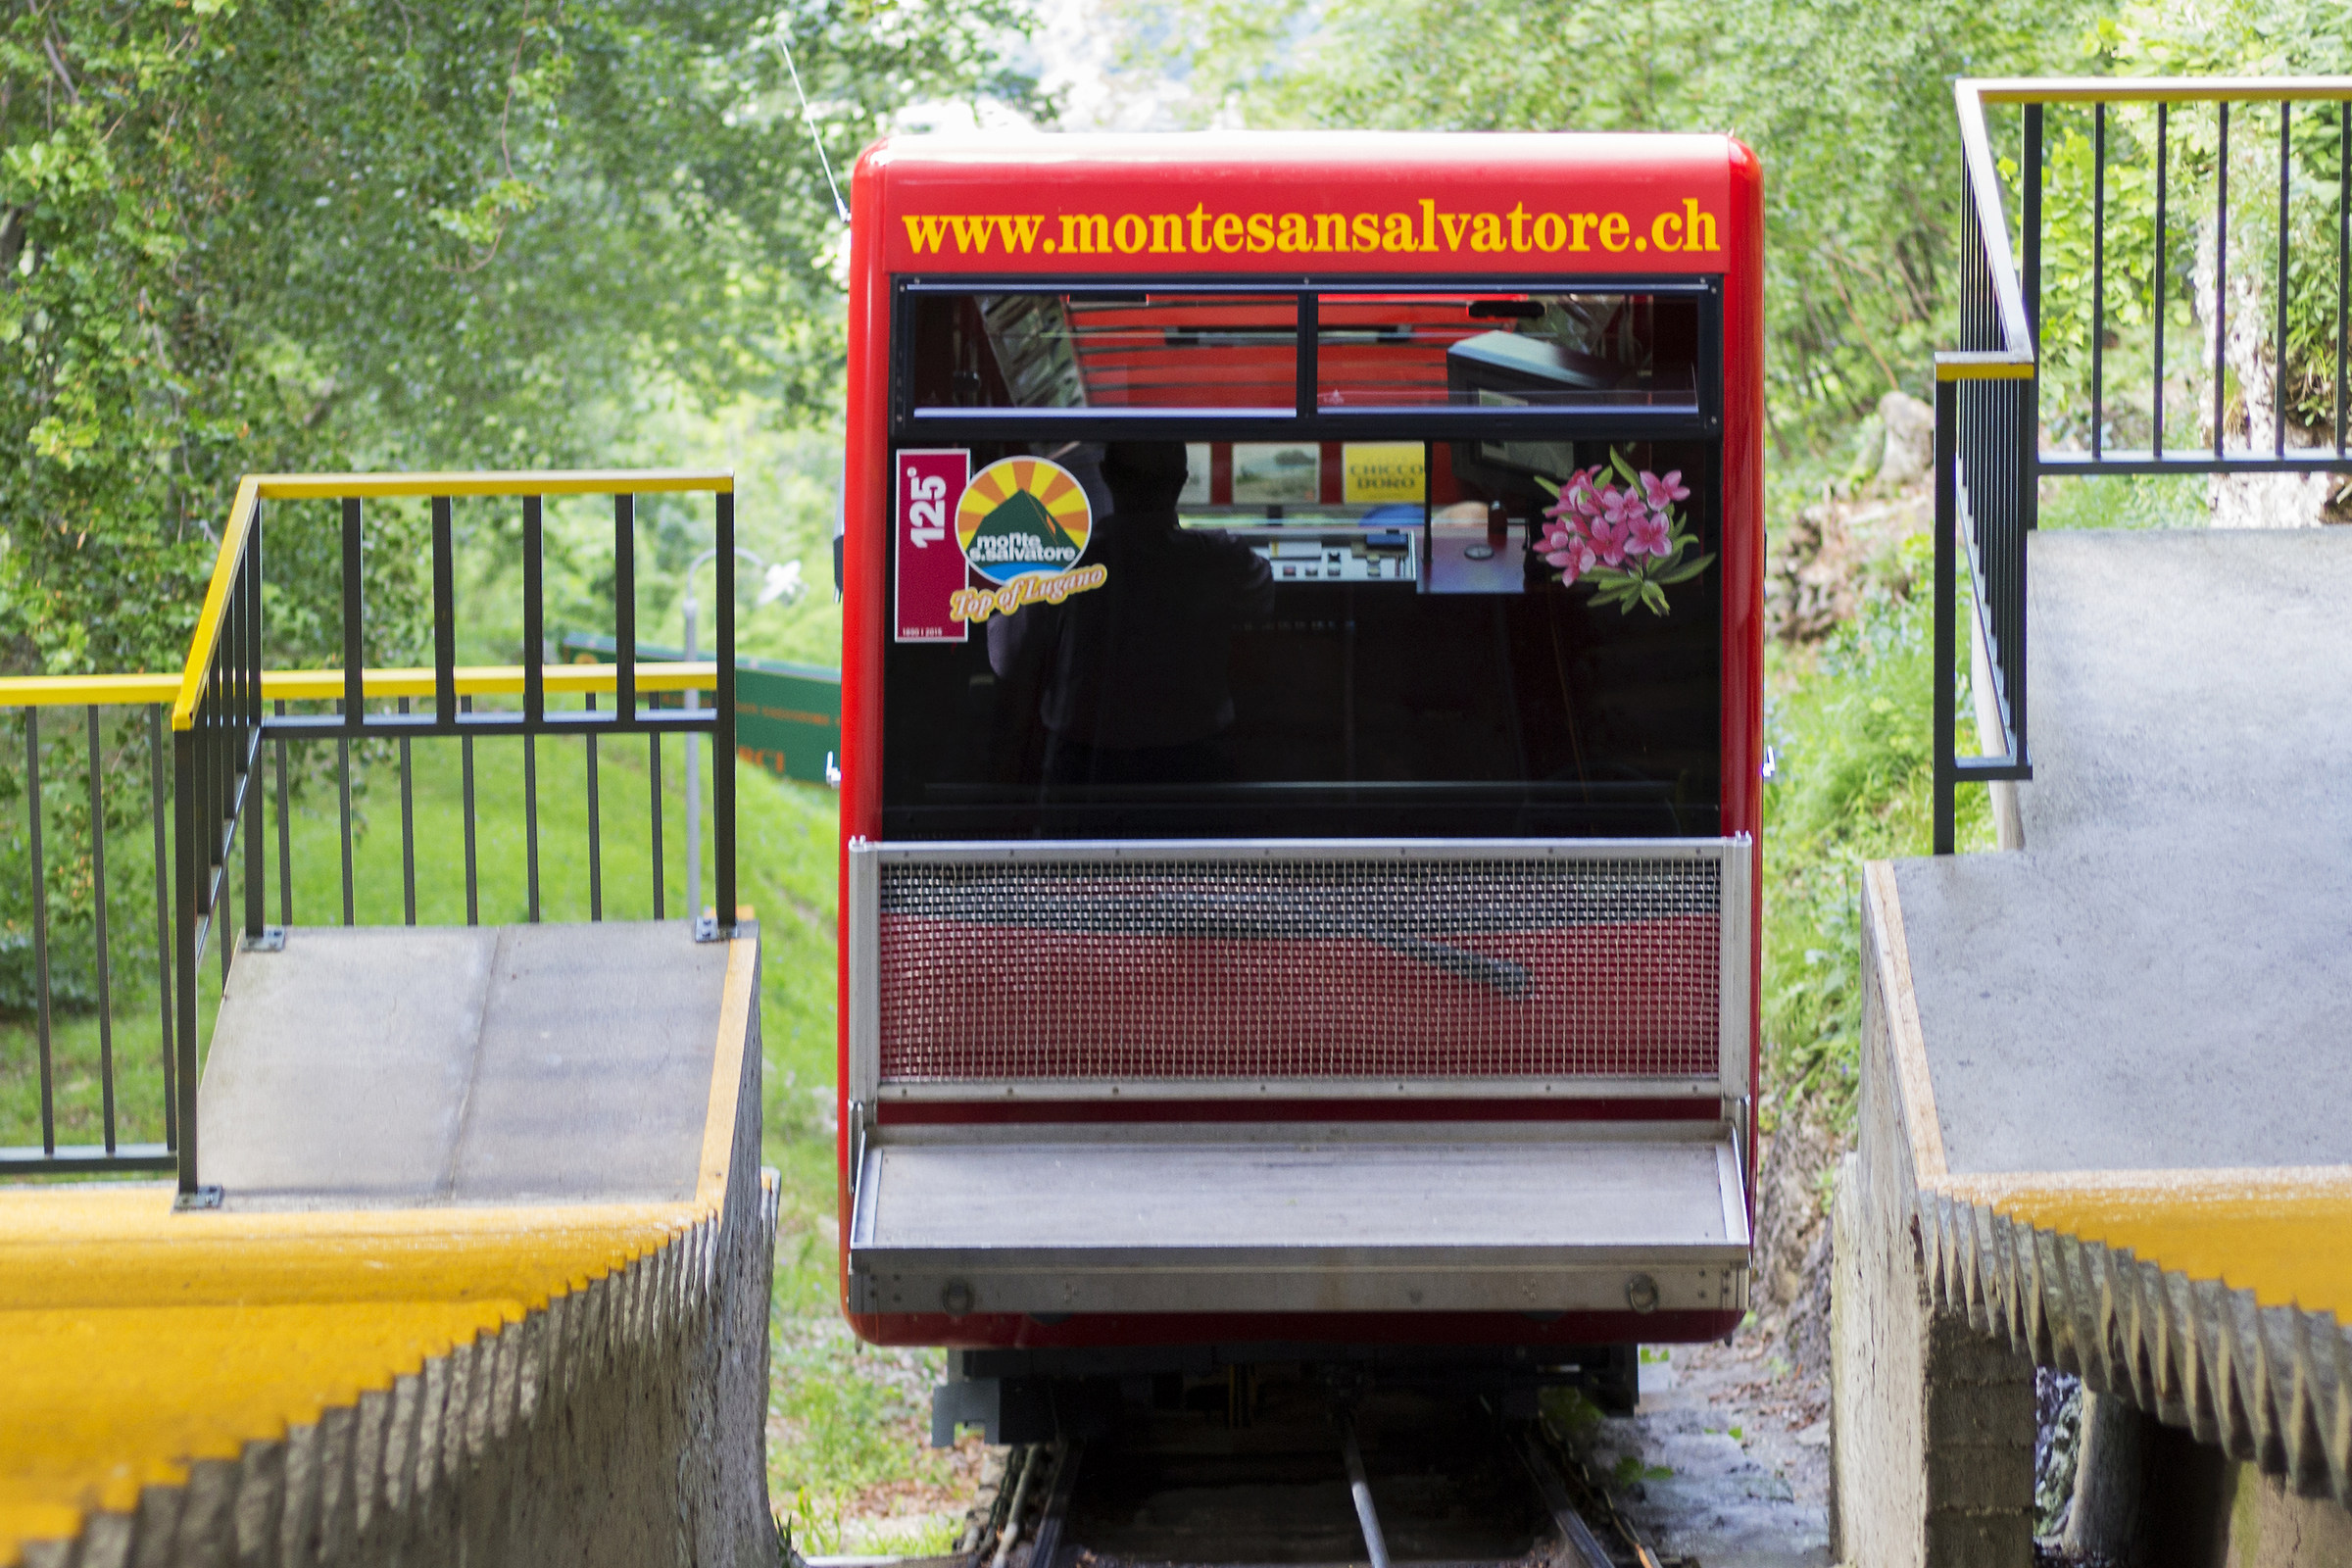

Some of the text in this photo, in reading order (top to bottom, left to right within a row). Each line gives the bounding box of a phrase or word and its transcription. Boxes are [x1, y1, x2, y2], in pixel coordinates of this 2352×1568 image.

[902, 198, 1721, 254] www.montesansalvatore.ch
[977, 532, 1041, 549] monte
[952, 568, 1103, 617] Top of Lugano
